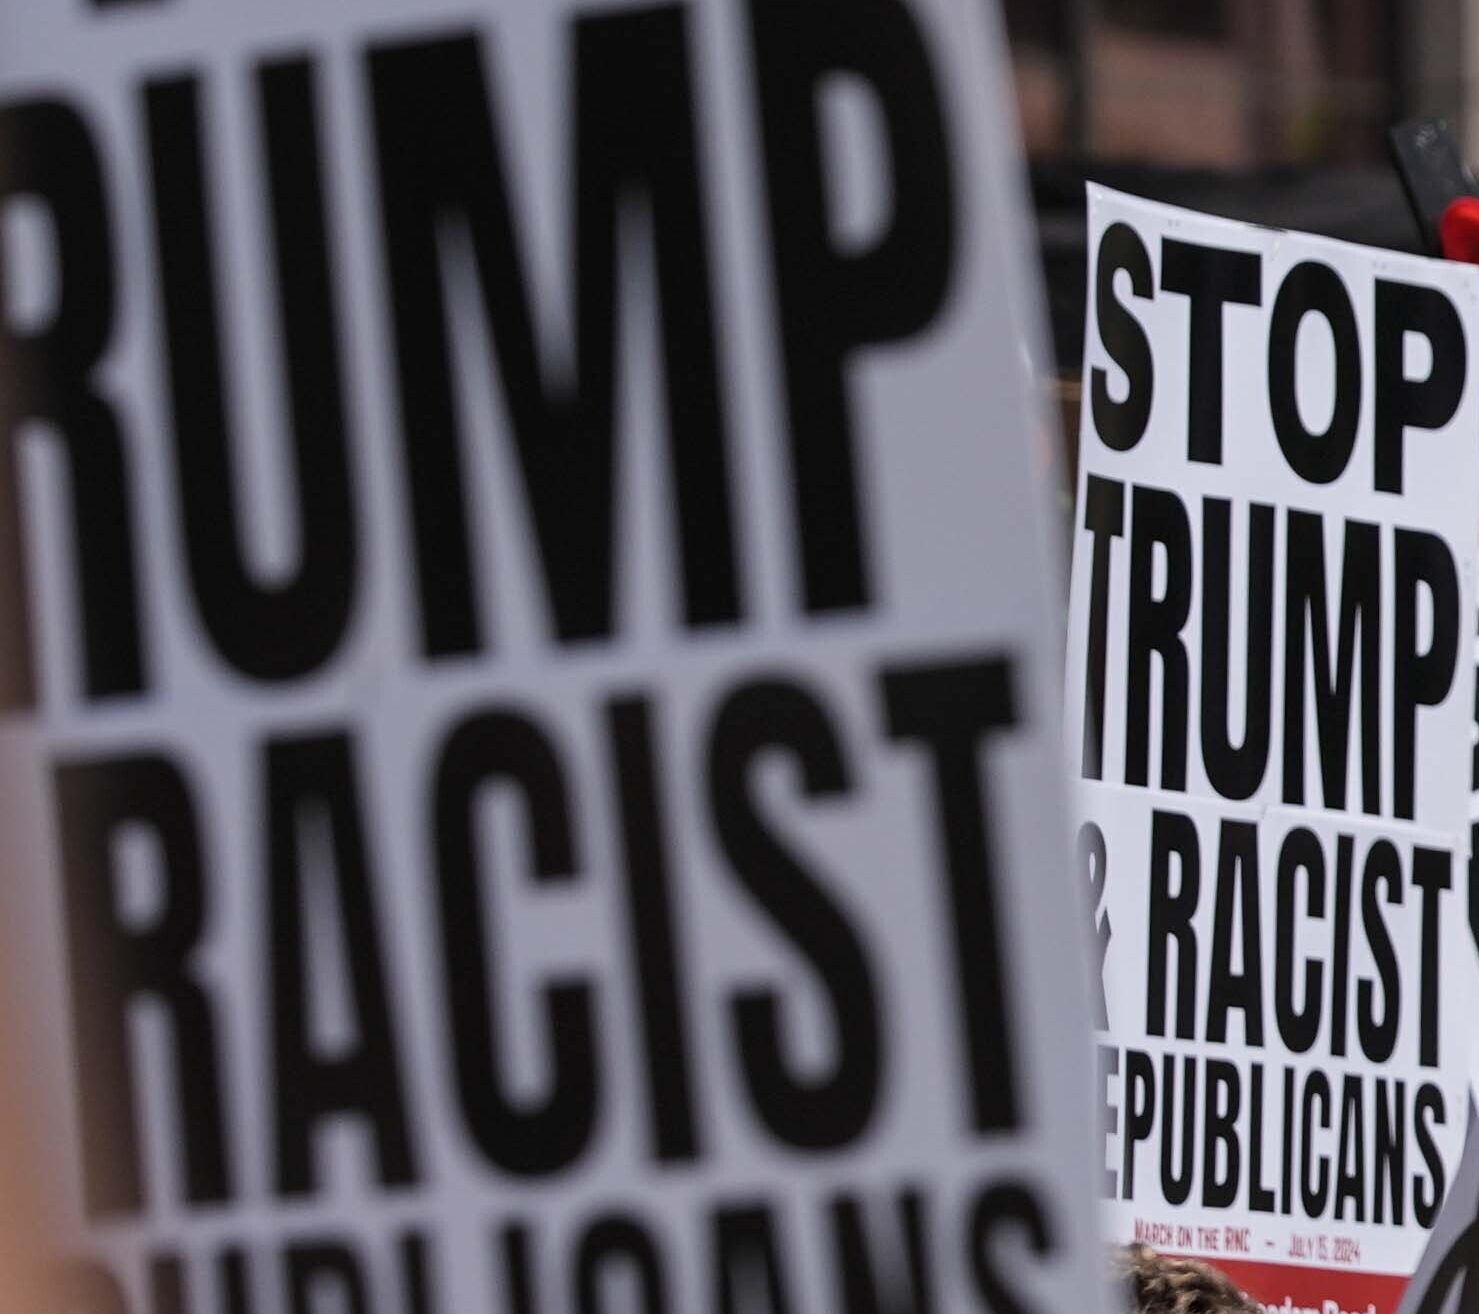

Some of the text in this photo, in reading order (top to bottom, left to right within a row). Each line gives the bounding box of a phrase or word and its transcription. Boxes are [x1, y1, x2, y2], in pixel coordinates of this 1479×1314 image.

[1090, 221, 1468, 496] STOP
[1080, 472, 1461, 821] TRUMP
[52, 655, 1027, 1222] RACIST
[1145, 807, 1453, 1069] RACIST
[1098, 1043, 1448, 1230] EPUBLICANS
